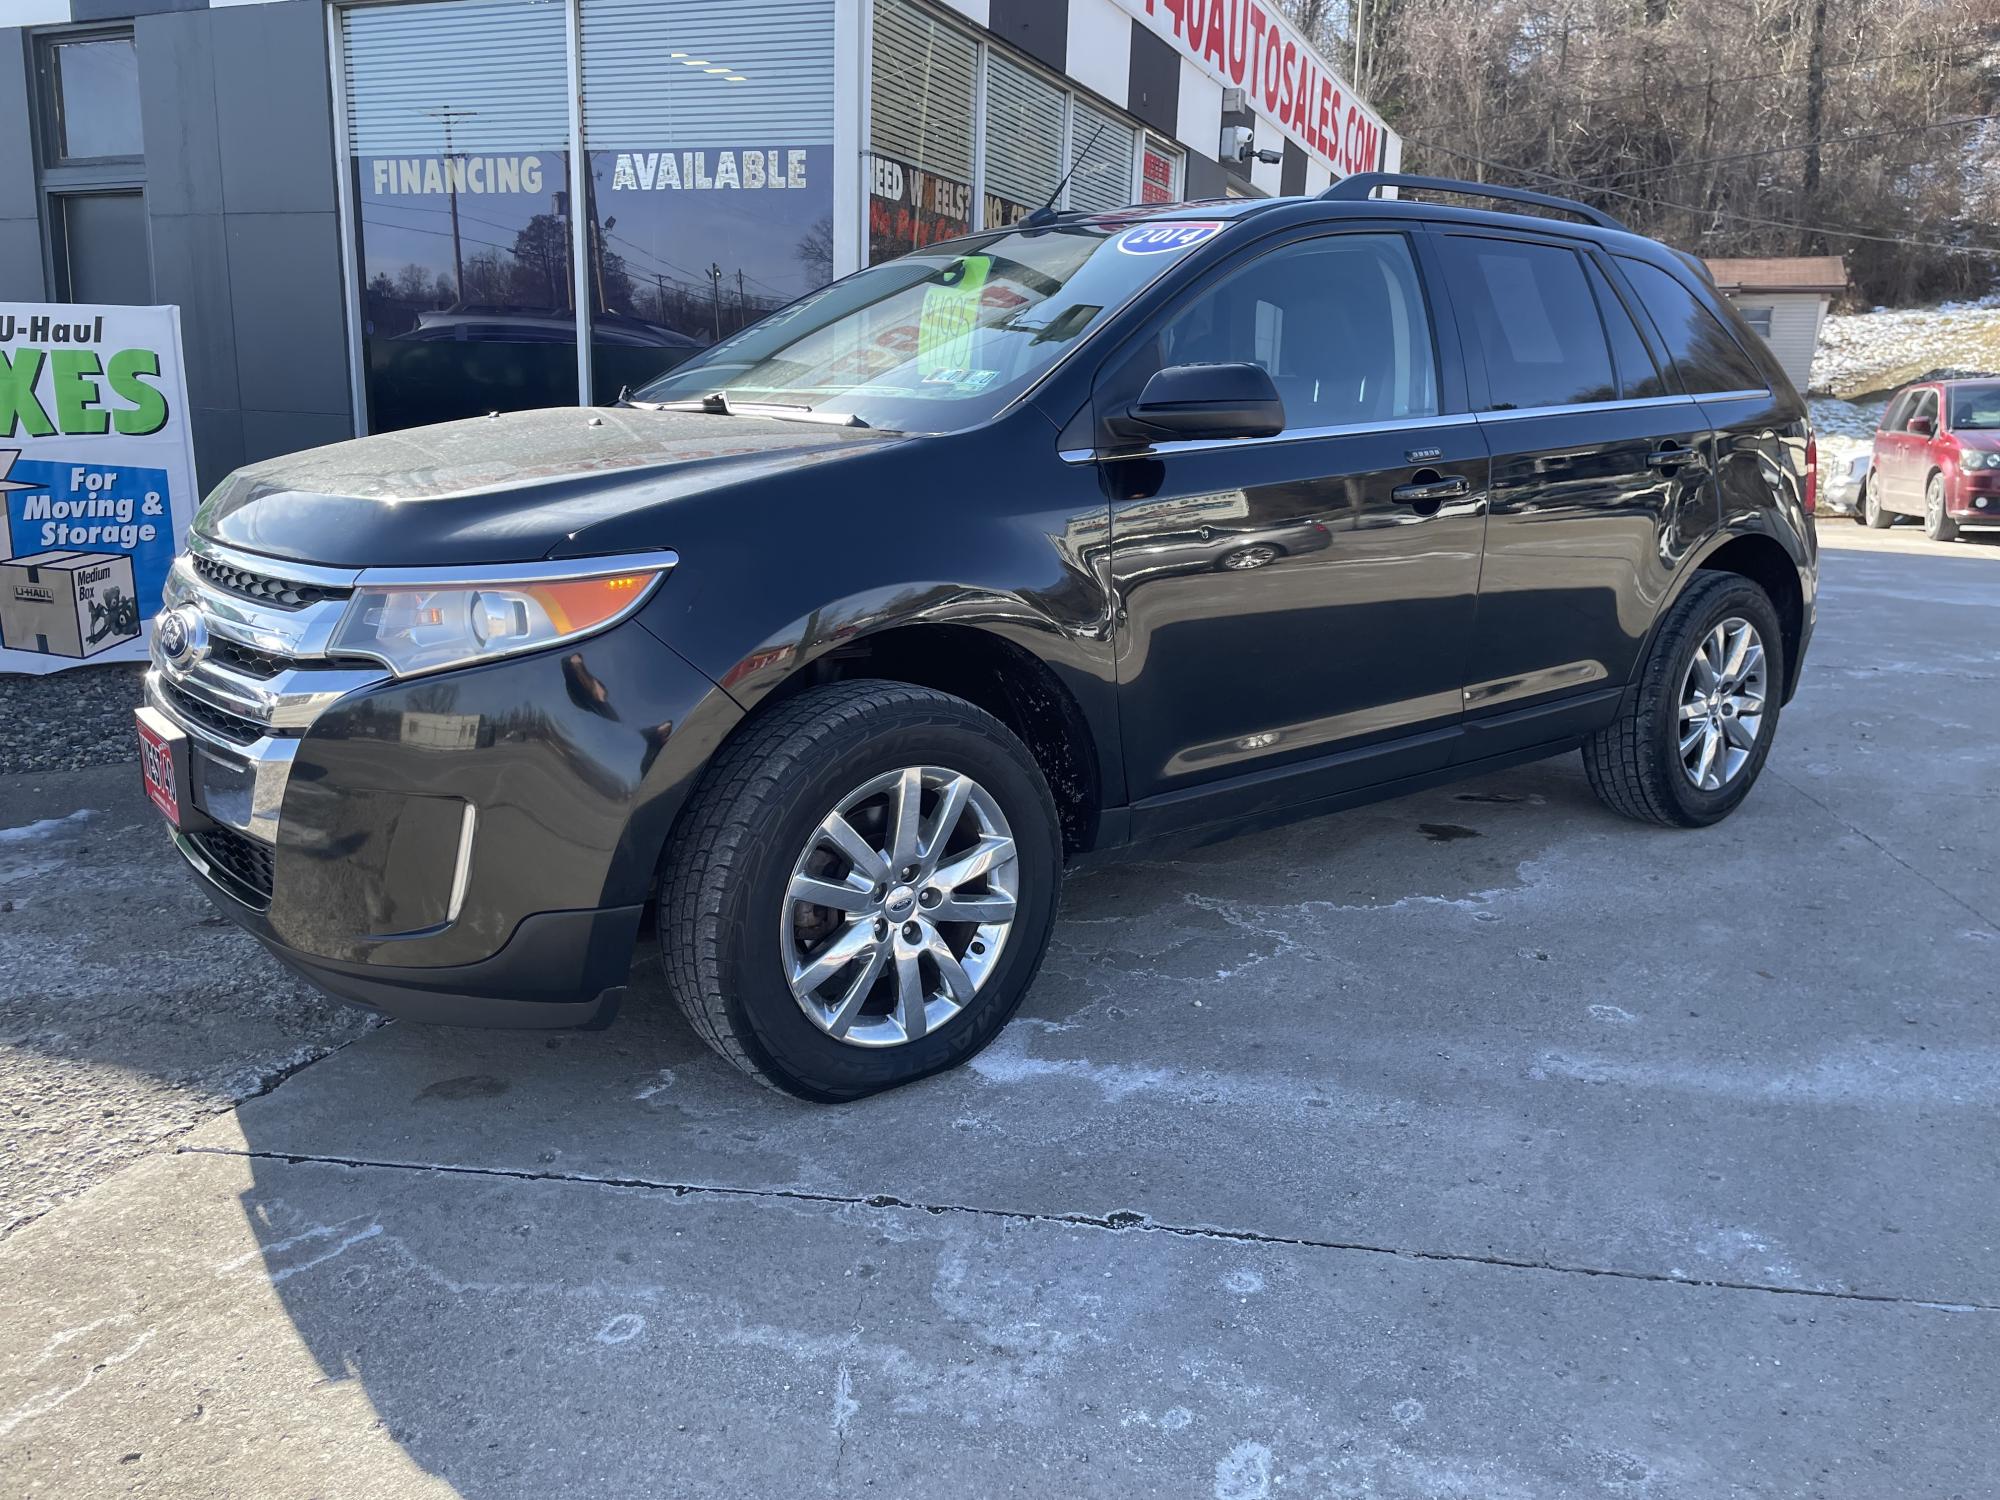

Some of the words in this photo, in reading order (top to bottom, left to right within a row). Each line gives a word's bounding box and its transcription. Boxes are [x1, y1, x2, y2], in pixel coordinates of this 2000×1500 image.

[1145, 0, 1378, 174] 0AUTOSALES.COM
[373, 155, 543, 195] FINANCING
[612, 149, 808, 191] AVAILABLE
[1126, 228, 1205, 244] 2014
[0, 315, 103, 343] U-Haul
[0, 347, 169, 438] XES
[70, 467, 117, 492] For
[23, 492, 134, 523] Moving
[141, 491, 163, 516] &
[40, 521, 156, 549] Storage
[77, 567, 111, 587] Medium
[15, 586, 53, 599] U-HAUL
[79, 586, 95, 602] Box
